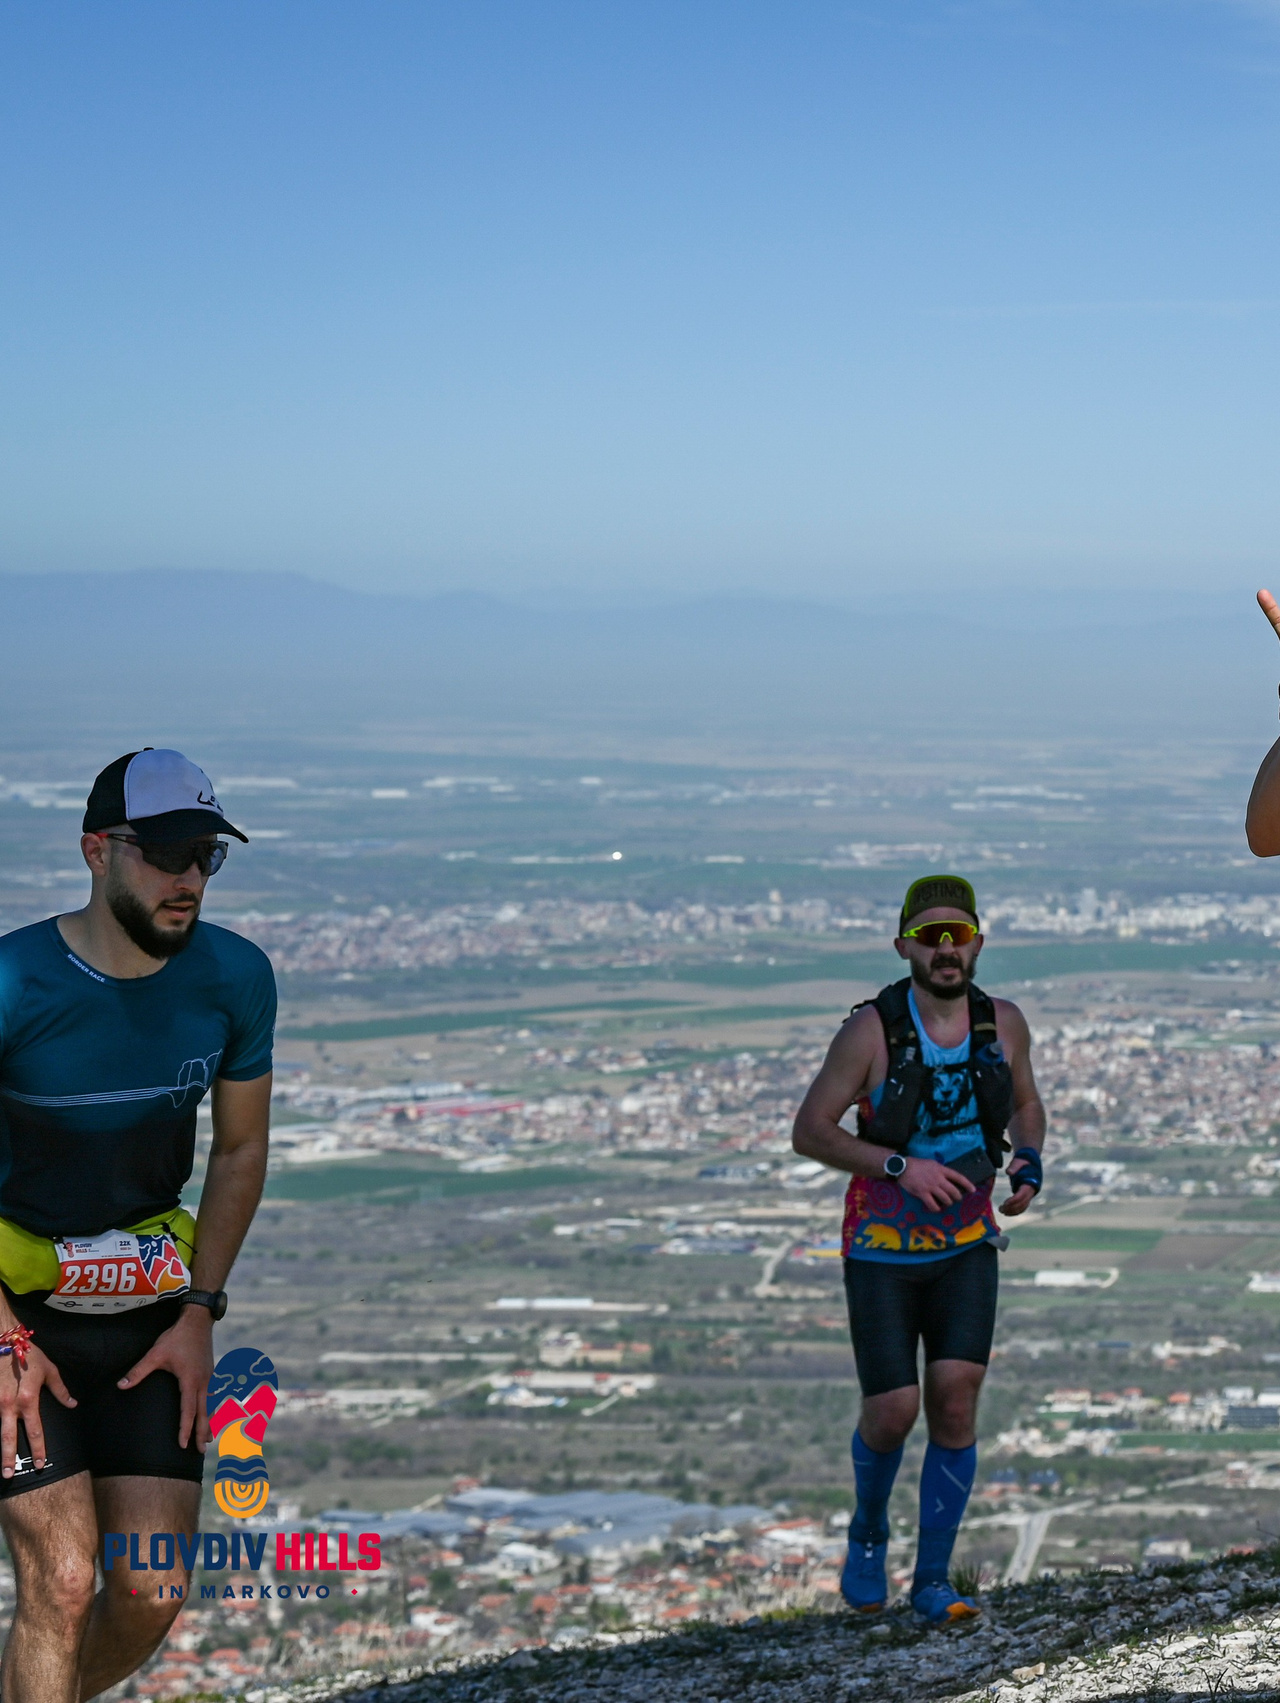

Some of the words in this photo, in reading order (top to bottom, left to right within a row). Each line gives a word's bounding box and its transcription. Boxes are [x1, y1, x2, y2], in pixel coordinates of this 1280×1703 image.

[67, 953, 90, 973] BORDER
[89, 971, 106, 983] RACE
[58, 1262, 138, 1294] 2396
